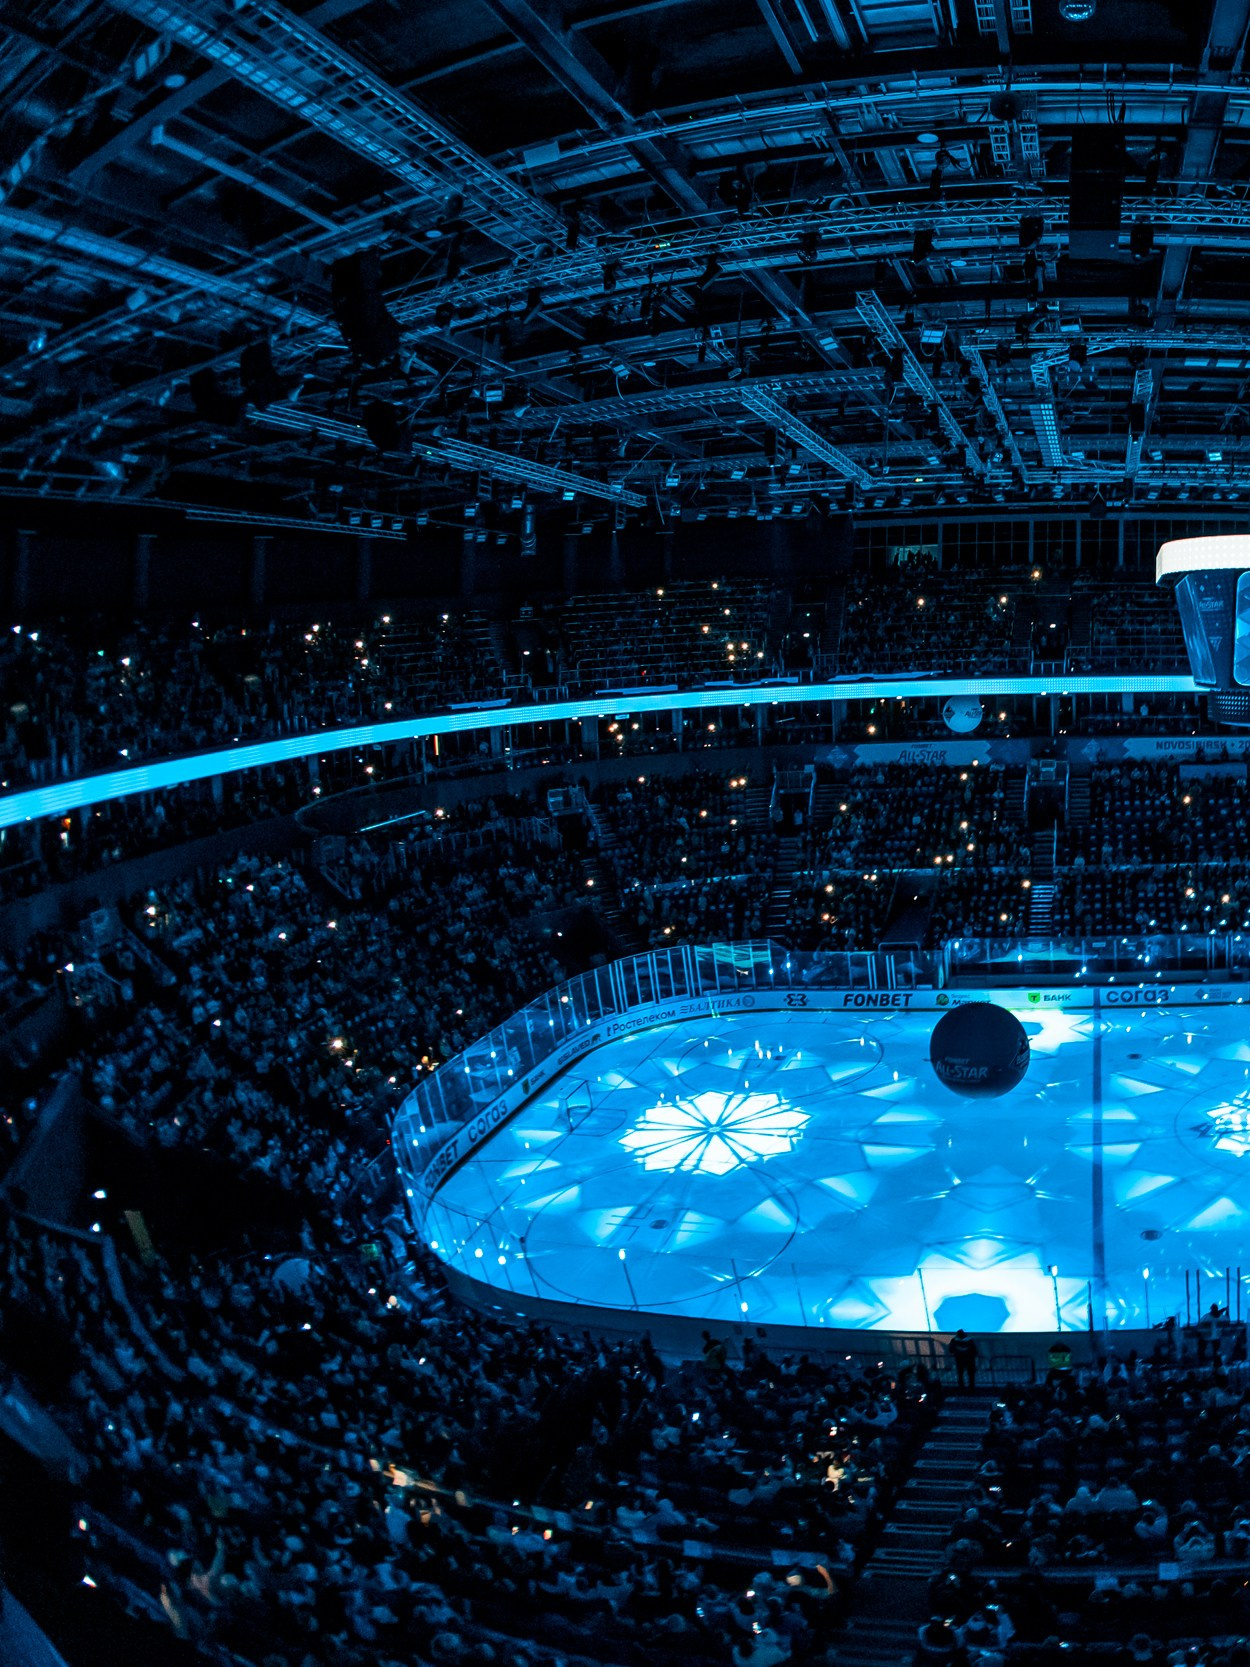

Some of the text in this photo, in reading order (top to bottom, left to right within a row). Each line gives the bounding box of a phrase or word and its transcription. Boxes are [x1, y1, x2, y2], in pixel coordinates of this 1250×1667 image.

[1156, 740, 1228, 751] NOVOSIBIRSK
[843, 993, 913, 1007] FONBET
[1043, 993, 1072, 1002] БАНК
[689, 997, 741, 1013] БАЛТИКА
[612, 1010, 676, 1034] Ростелеком
